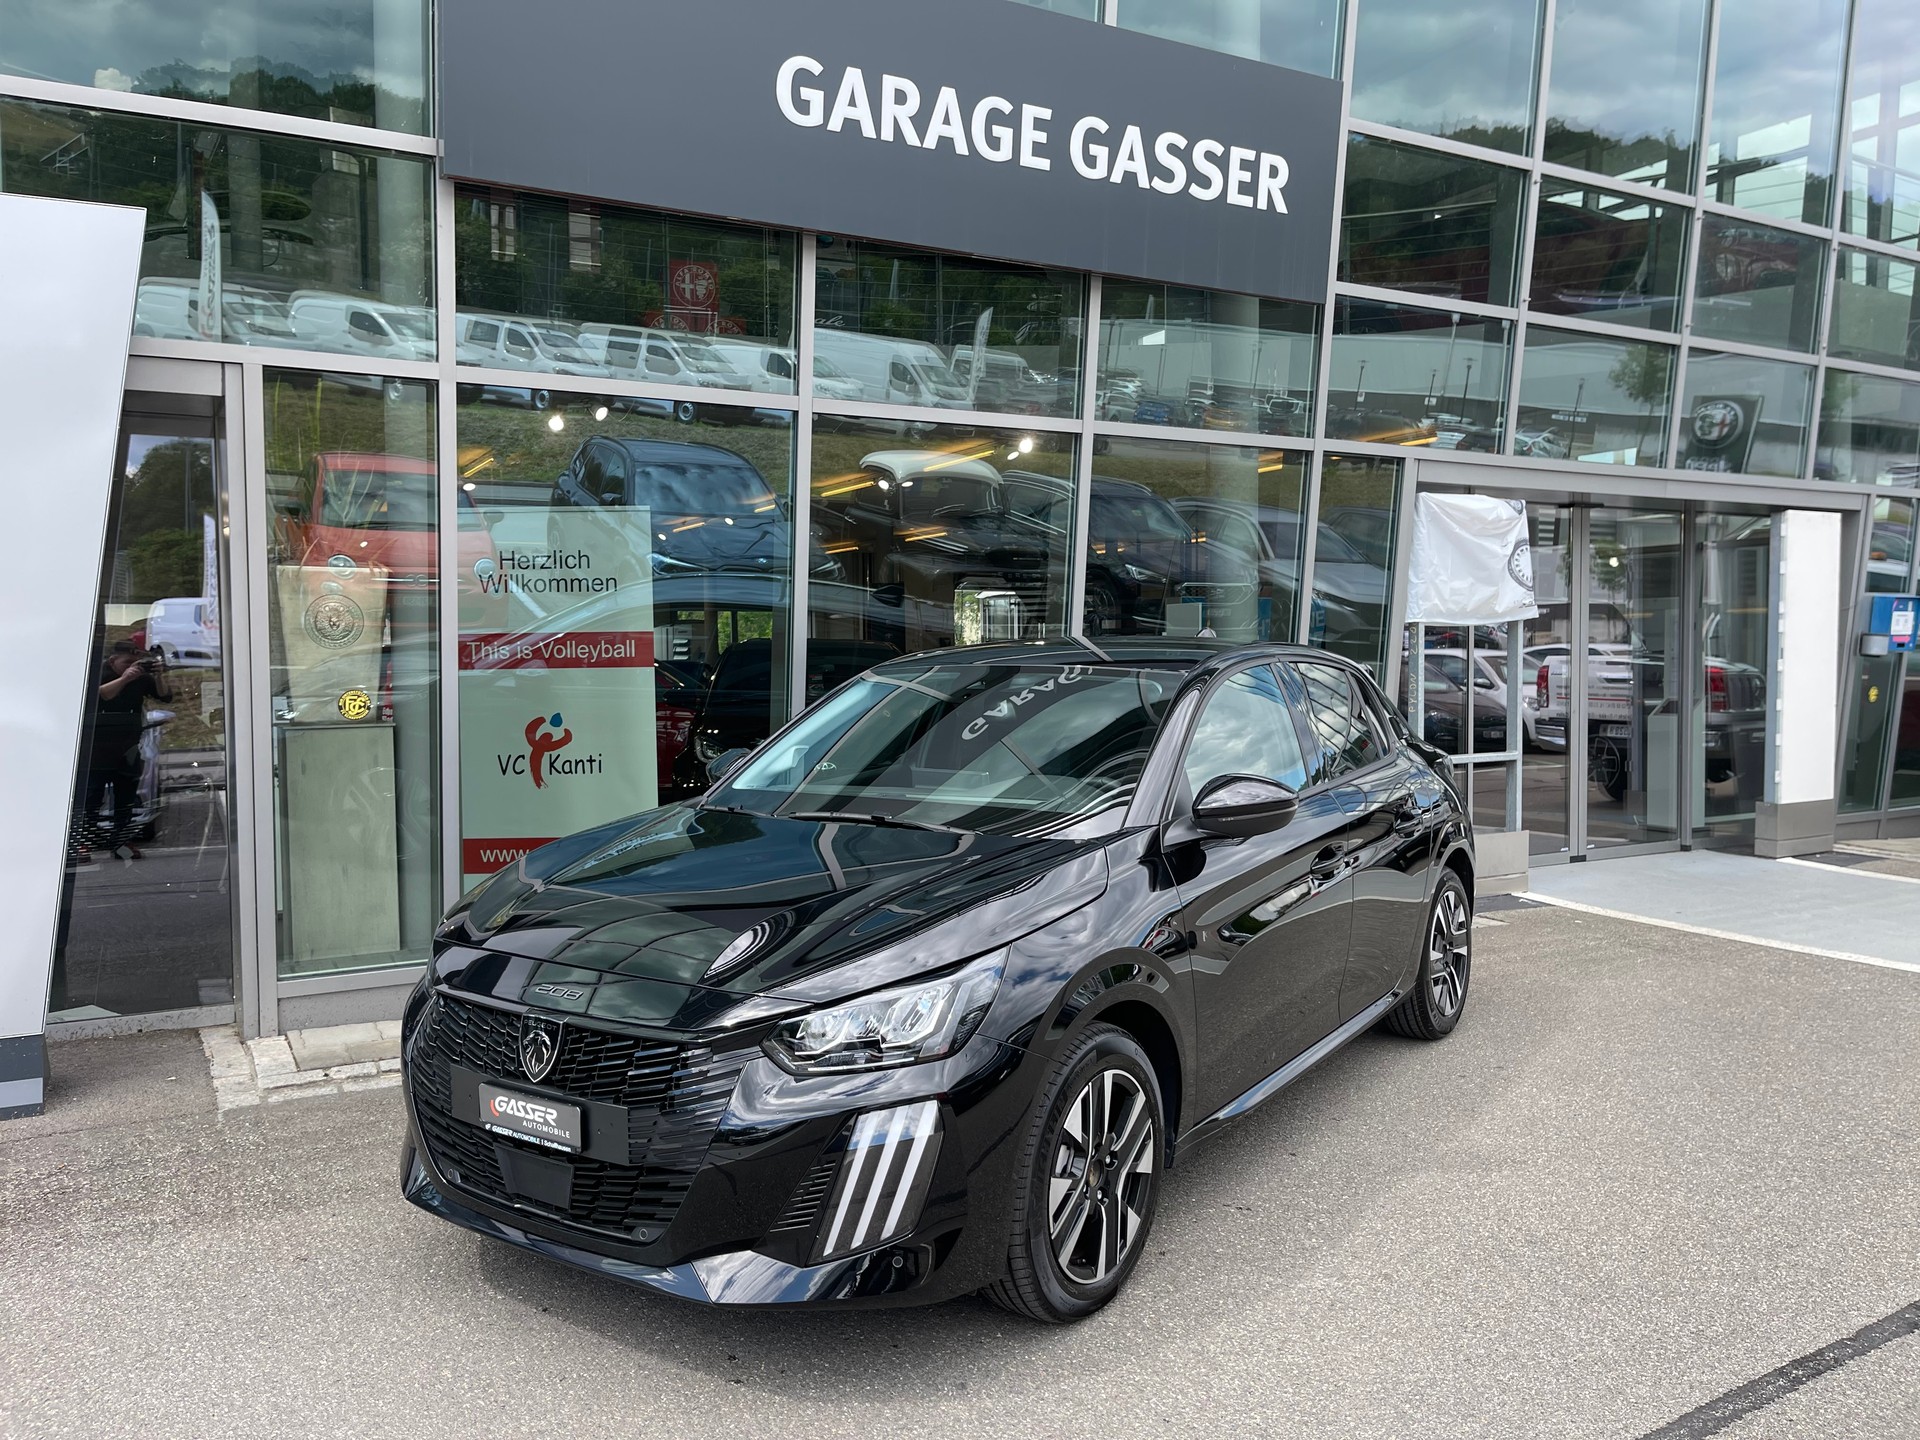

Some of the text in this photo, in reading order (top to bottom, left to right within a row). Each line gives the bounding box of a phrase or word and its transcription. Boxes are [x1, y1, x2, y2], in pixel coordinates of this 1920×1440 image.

[776, 55, 1290, 215] GARAGE GASSER
[499, 550, 590, 571] Herzlich
[479, 574, 618, 594] Willkommen
[466, 640, 636, 663] This is Volleyball
[497, 753, 603, 776] VC Kanti
[535, 983, 583, 1001] 208
[523, 1020, 557, 1031] PEUGEOT
[493, 1096, 557, 1126] GASSER
[522, 1120, 571, 1139] AUTOMOBILE
